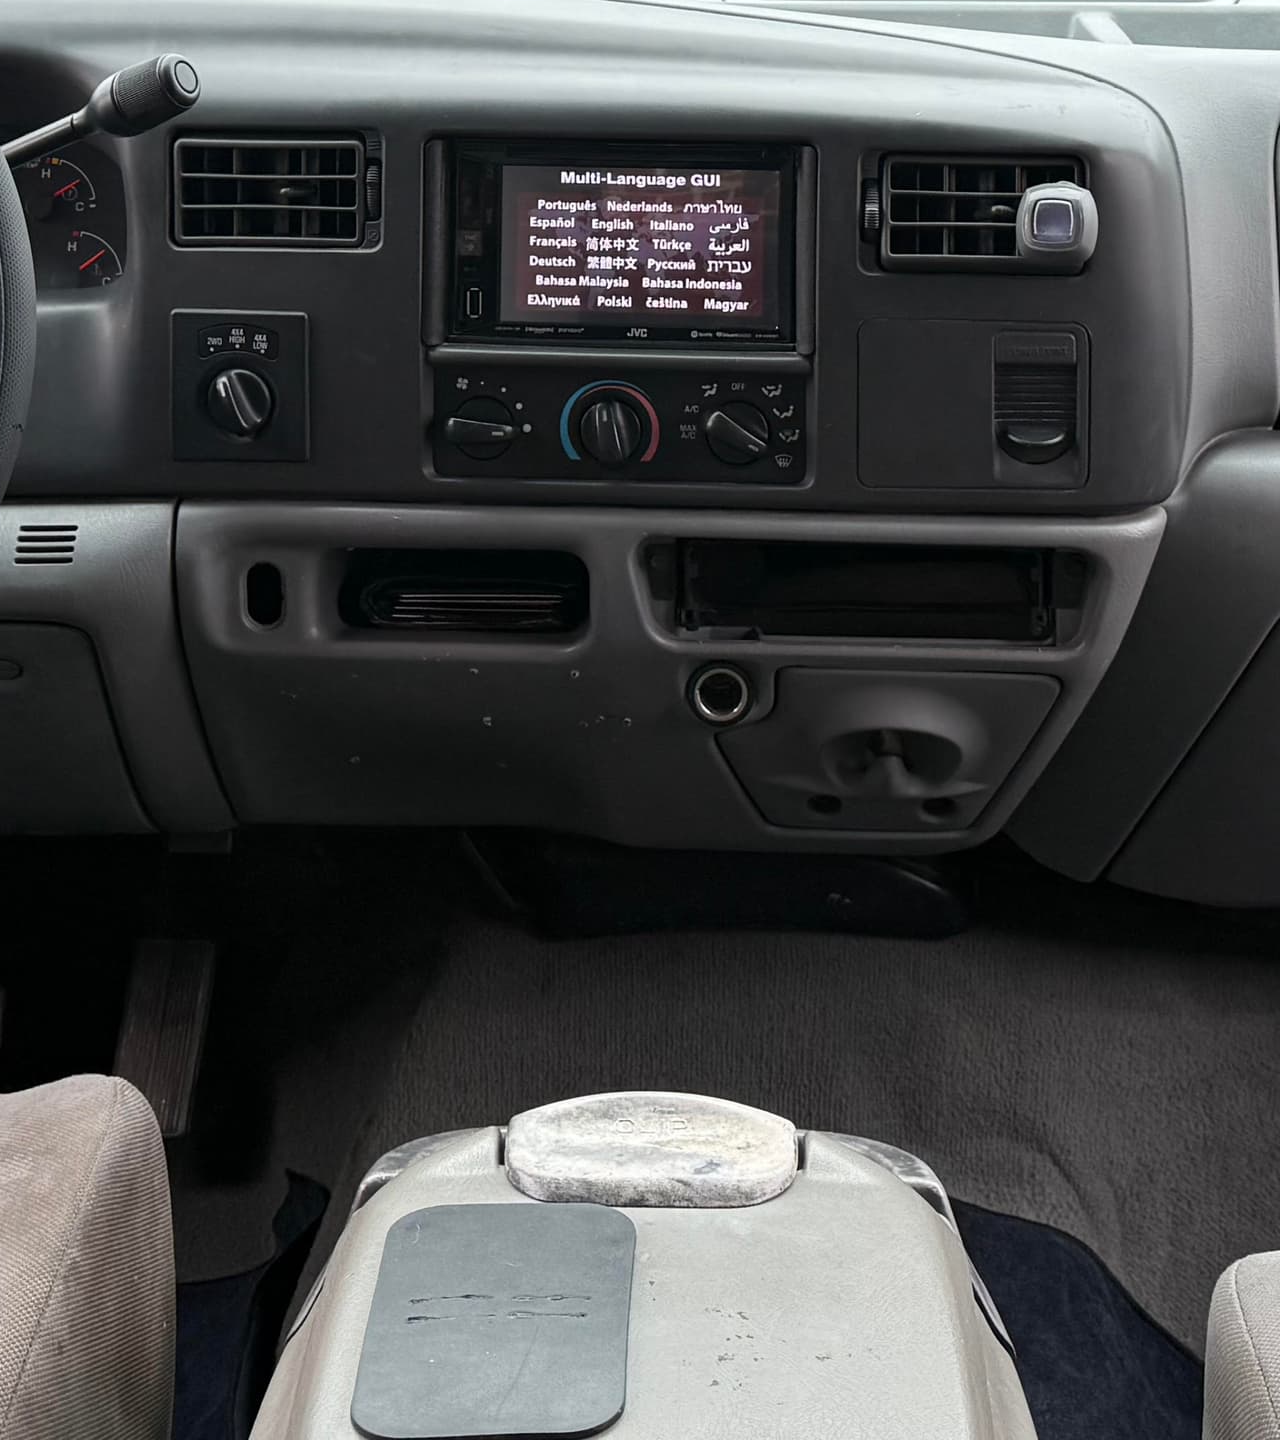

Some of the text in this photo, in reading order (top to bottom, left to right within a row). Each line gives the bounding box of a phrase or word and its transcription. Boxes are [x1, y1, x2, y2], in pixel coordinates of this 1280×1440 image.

[41, 168, 51, 179] H
[560, 171, 721, 188] Multi-Language GUI
[75, 202, 84, 212] C
[537, 199, 673, 214] Português Nederlands
[529, 216, 694, 233] Español English Italiano
[67, 241, 77, 252] H
[529, 235, 578, 251] Français
[586, 236, 640, 253] 简体中文
[652, 238, 692, 255] Türkçe
[529, 255, 576, 268] Deutsch
[647, 258, 696, 272] Русский
[535, 275, 630, 290] Bahasa Malaysia
[642, 277, 743, 291] Bahasa Indonesia
[527, 294, 581, 309] Ελληνικά
[596, 295, 632, 309] Polski
[704, 298, 750, 313] Magyar
[229, 336, 246, 344] HIGH
[626, 328, 648, 338] JVC
[207, 337, 223, 346] 2WD
[253, 342, 269, 350] LOW
[684, 405, 700, 413] A/C
